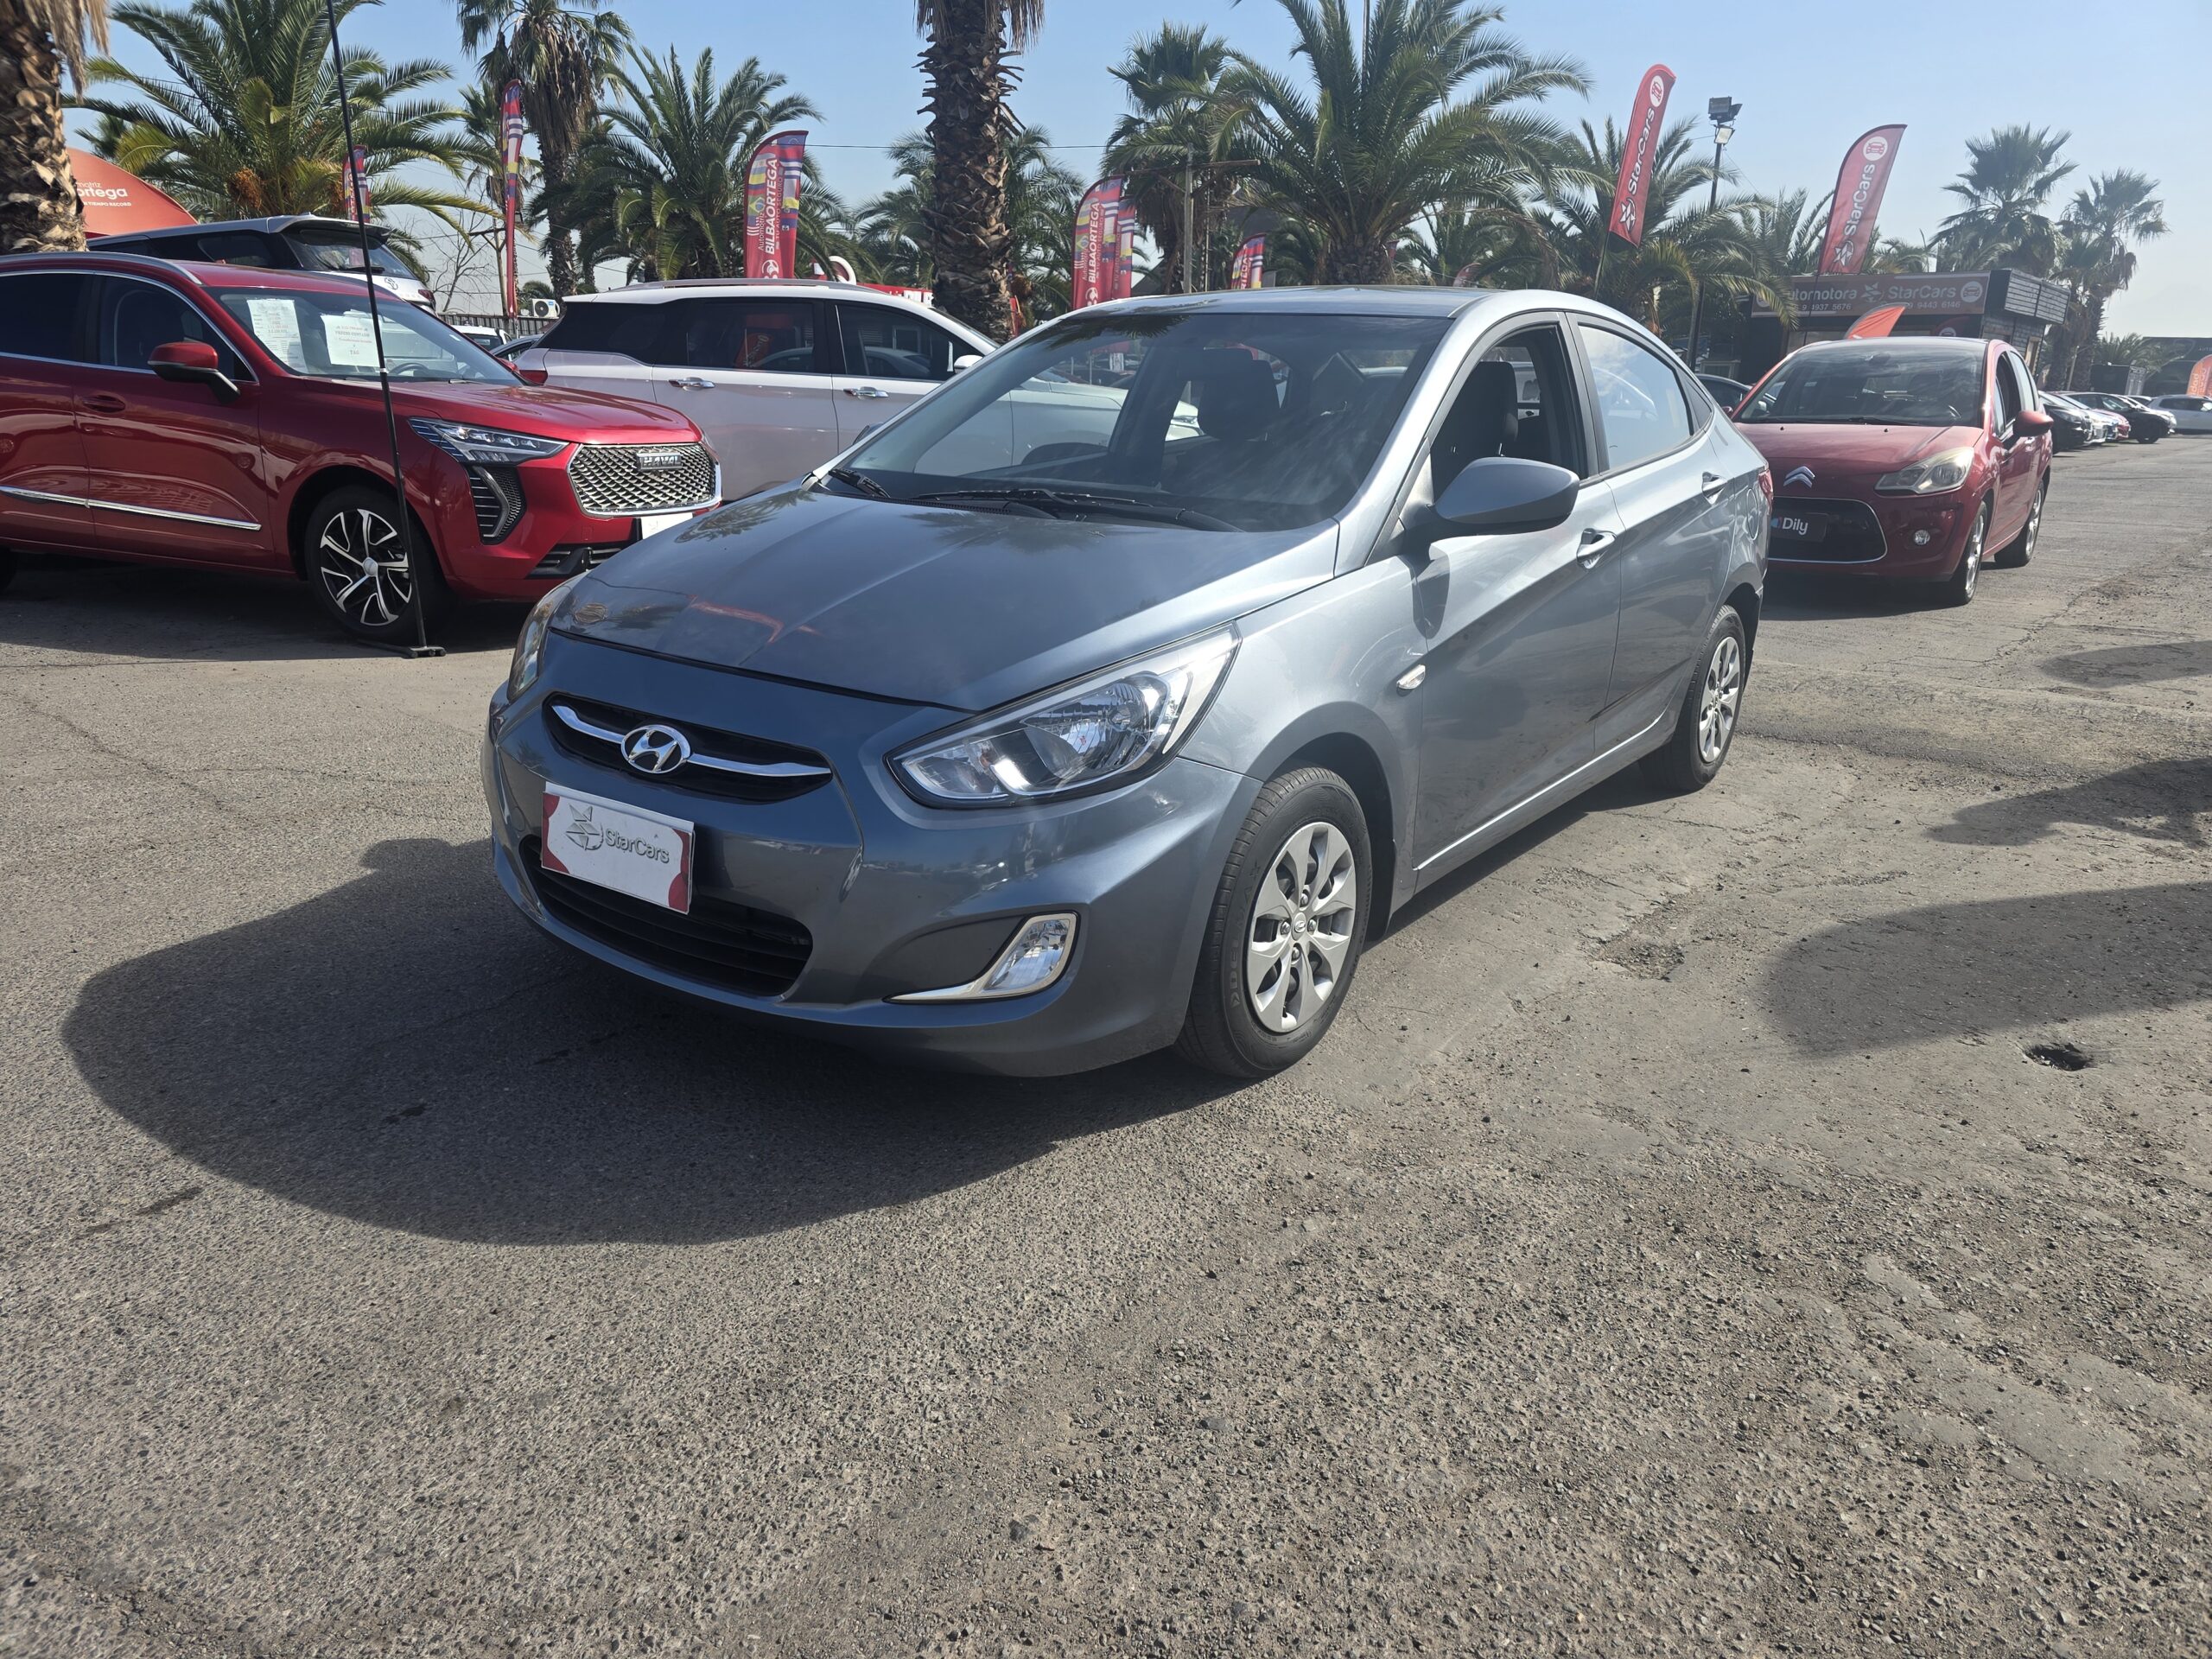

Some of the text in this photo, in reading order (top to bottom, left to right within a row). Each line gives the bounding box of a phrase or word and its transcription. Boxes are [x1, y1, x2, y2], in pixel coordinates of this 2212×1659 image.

[1628, 107, 1655, 195] StarCars
[765, 158, 778, 255] BILBAORTEGA
[1844, 163, 1876, 237] StarCars
[1088, 202, 1100, 283] BILBAORTEGA
[1888, 285, 1956, 299] StarCars
[1782, 517, 1808, 536] Dily
[604, 827, 671, 864] StarCars
